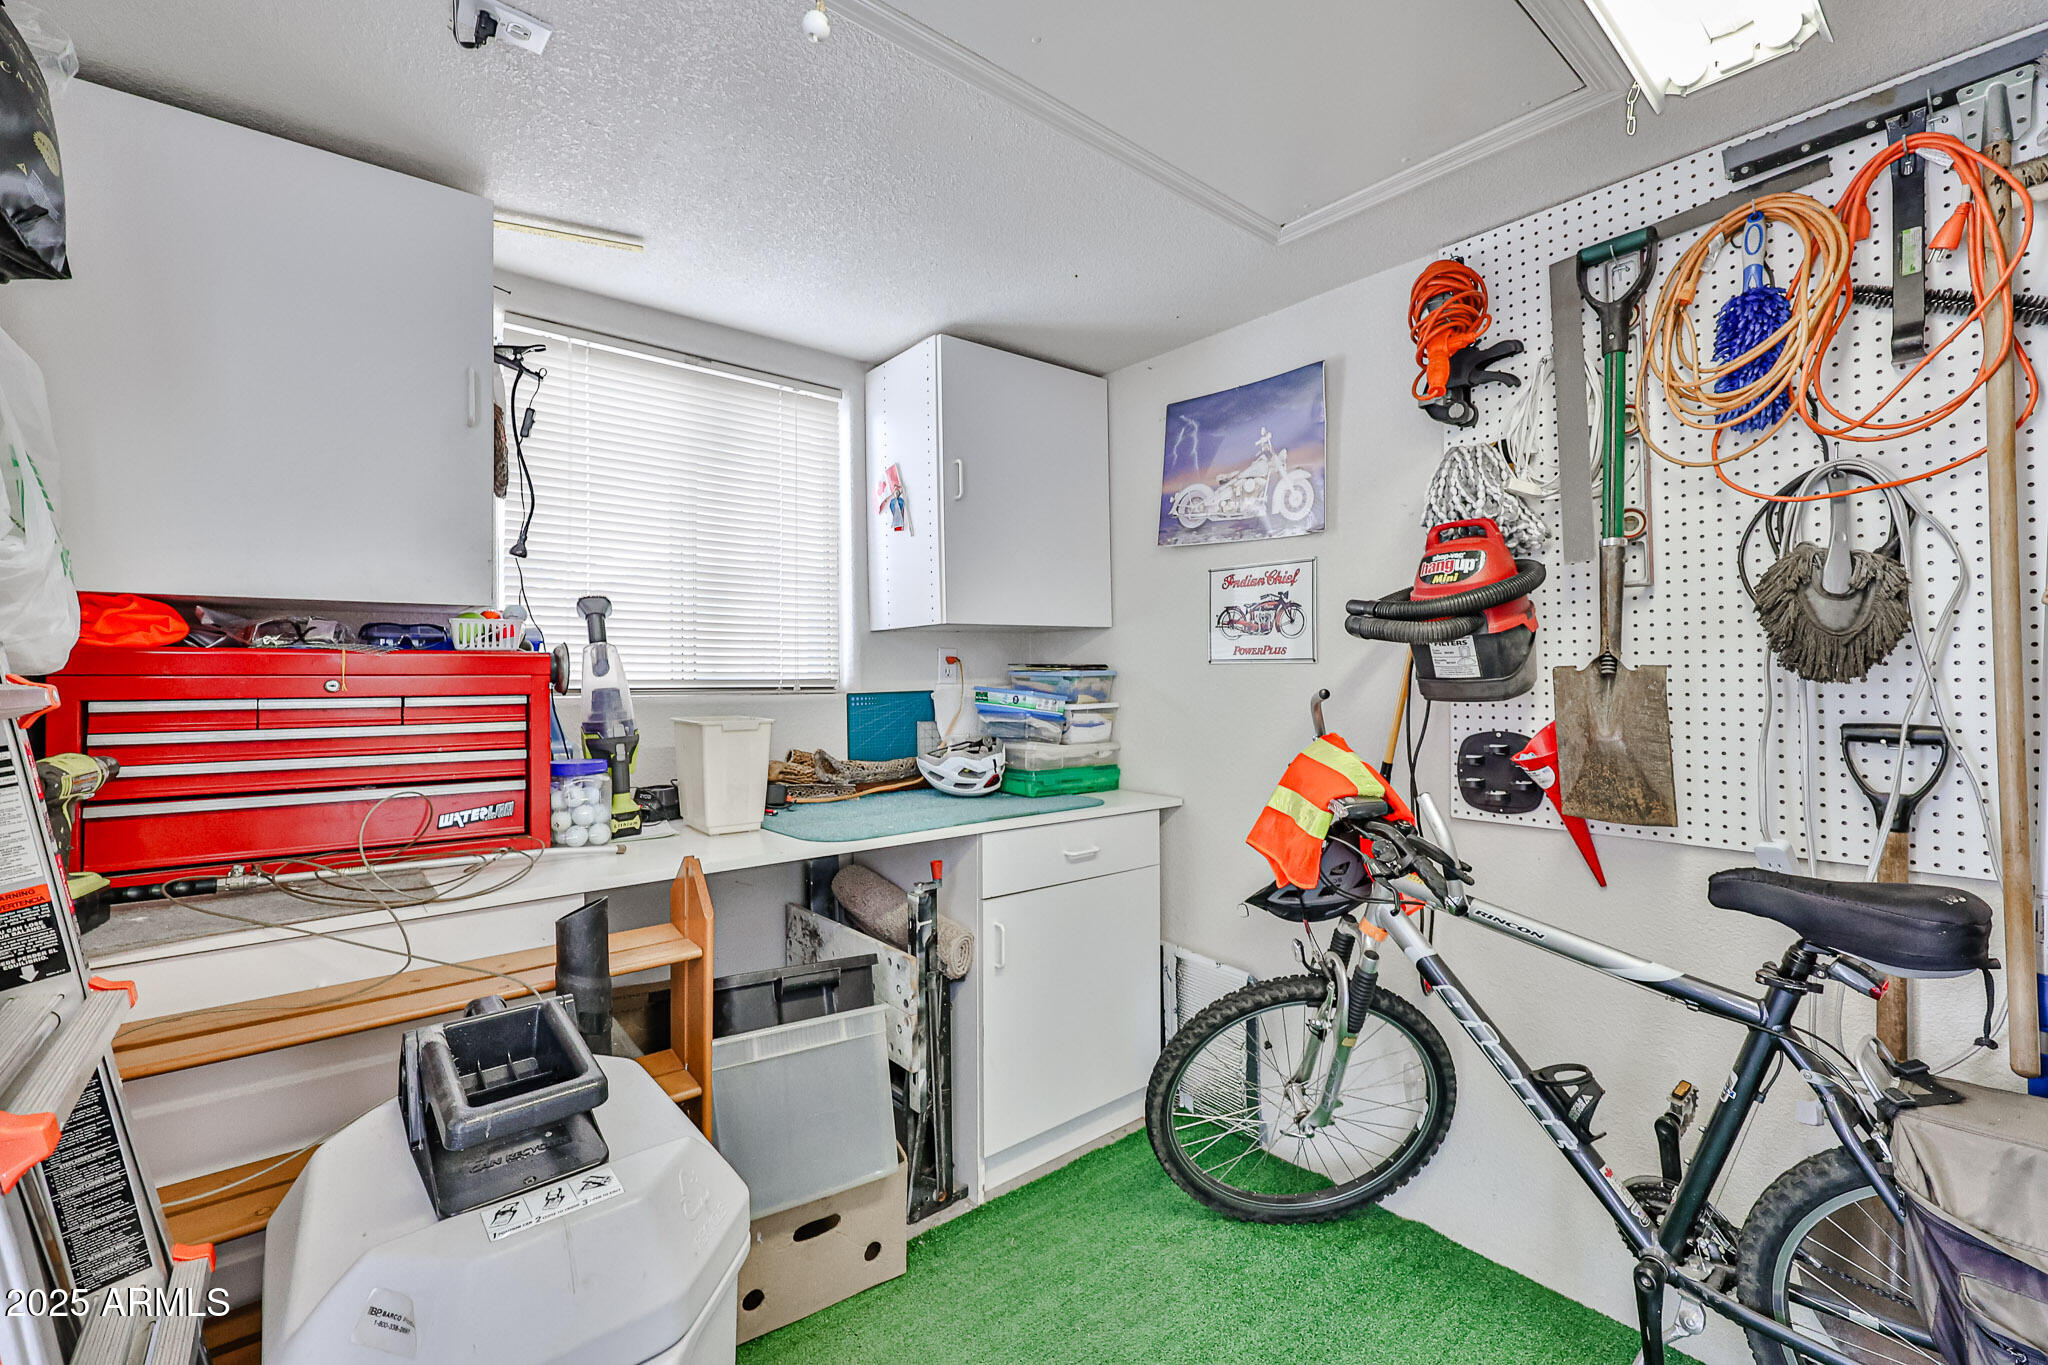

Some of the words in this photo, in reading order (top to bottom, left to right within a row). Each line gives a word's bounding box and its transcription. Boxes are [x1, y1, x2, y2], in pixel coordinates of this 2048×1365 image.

[1222, 574, 1265, 590] Indian
[1265, 568, 1300, 586] Chief
[1432, 573, 1459, 584] Mini
[1475, 910, 1545, 939] RINCON
